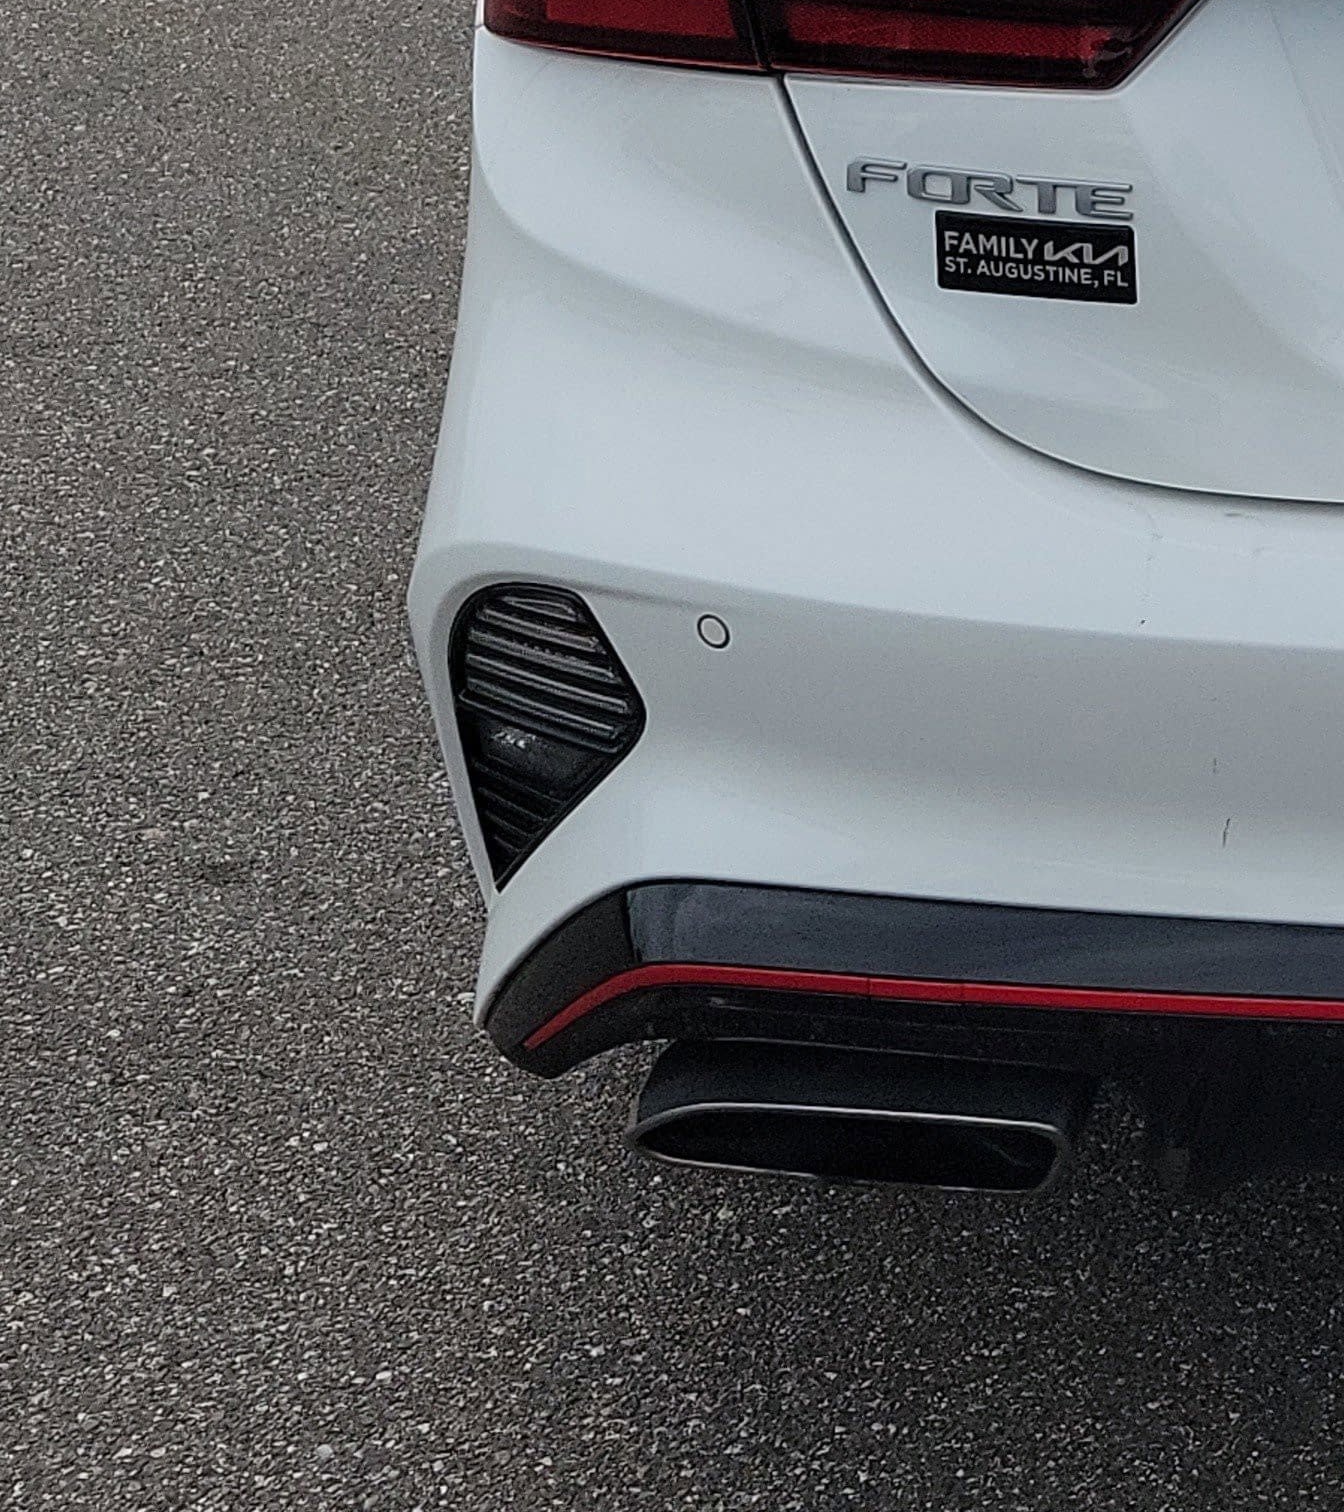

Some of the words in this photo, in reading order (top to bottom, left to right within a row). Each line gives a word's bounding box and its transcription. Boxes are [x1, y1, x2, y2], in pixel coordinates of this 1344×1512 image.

[846, 155, 1133, 220] FORTE
[944, 230, 1039, 261] FAMILY
[1044, 240, 1129, 266] KIA
[944, 256, 972, 274] ST.
[977, 259, 1099, 288] AUGUSTINE,
[1104, 270, 1129, 287] FL
